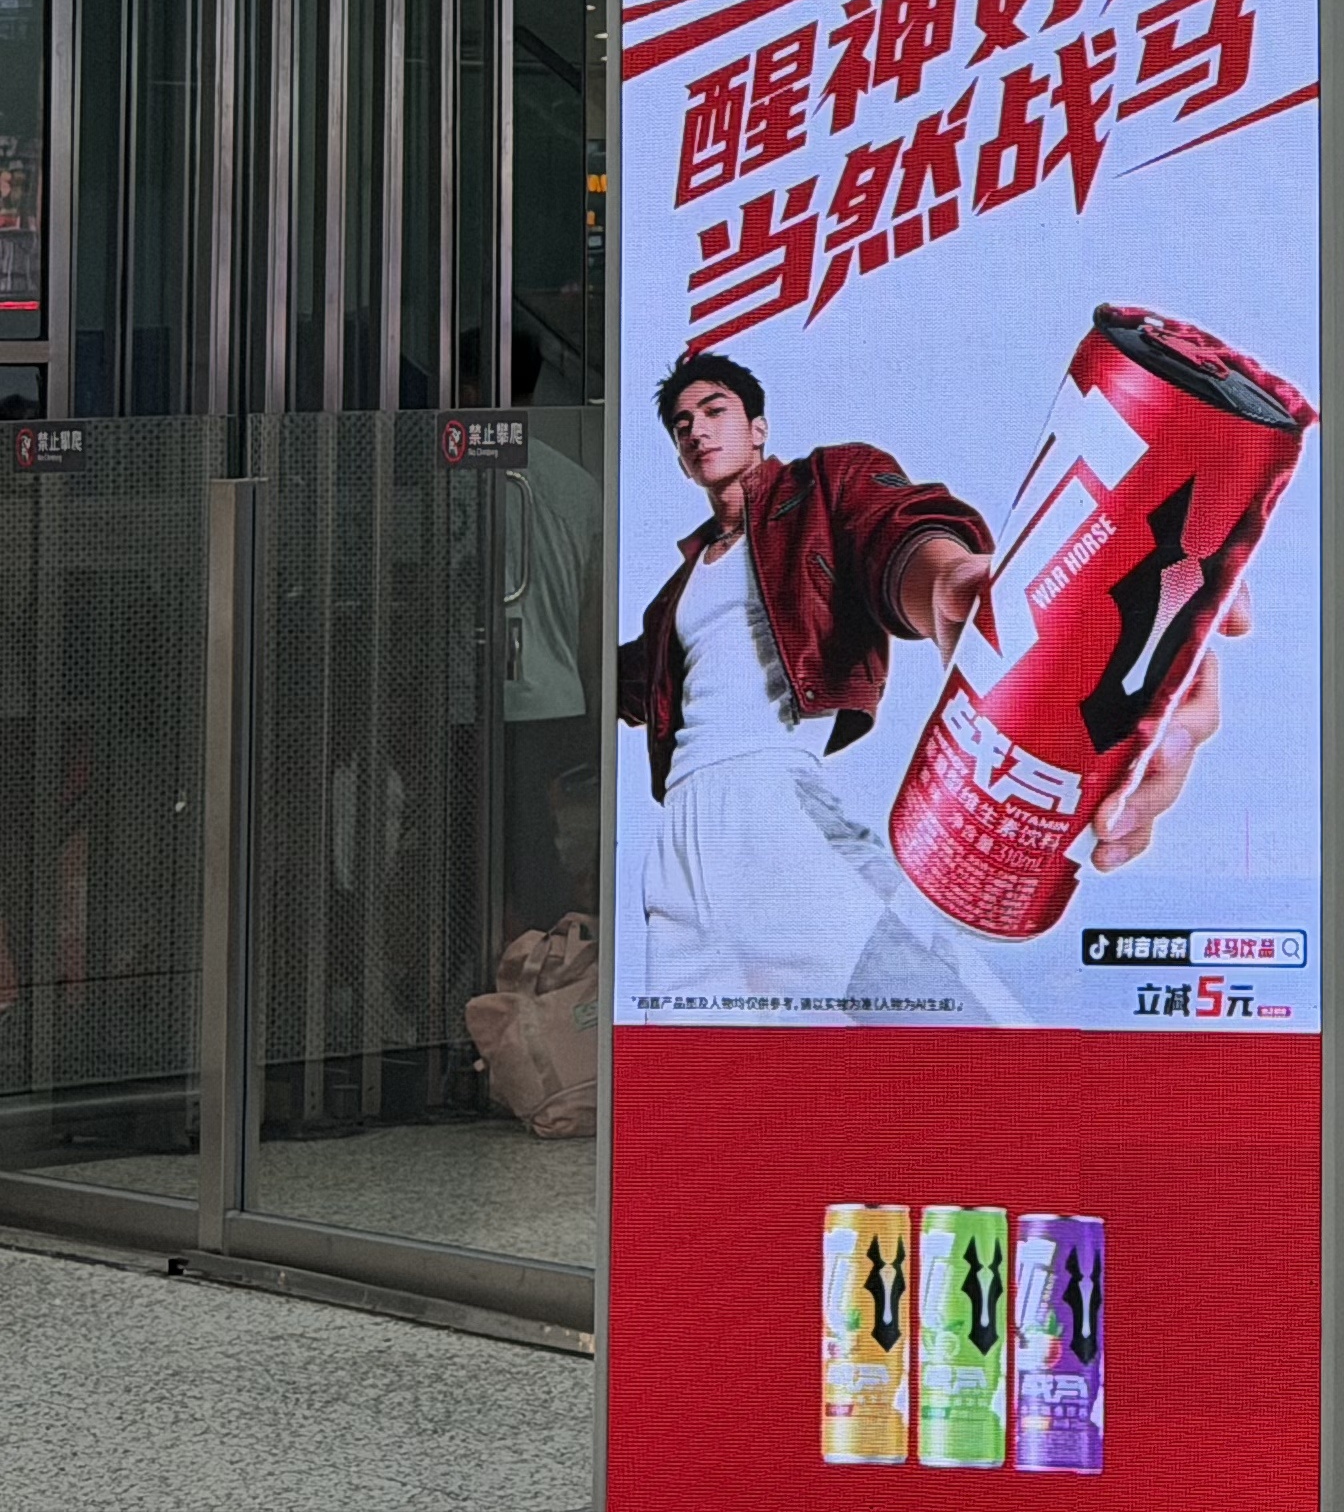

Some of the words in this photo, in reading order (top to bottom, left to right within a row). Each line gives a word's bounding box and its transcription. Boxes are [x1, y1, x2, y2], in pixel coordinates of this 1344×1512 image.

[1032, 565, 1071, 611] WAR
[1064, 512, 1118, 576] HORSE
[1203, 937, 1276, 960] 战马饮品
[1133, 975, 1255, 1017] 立减5元
